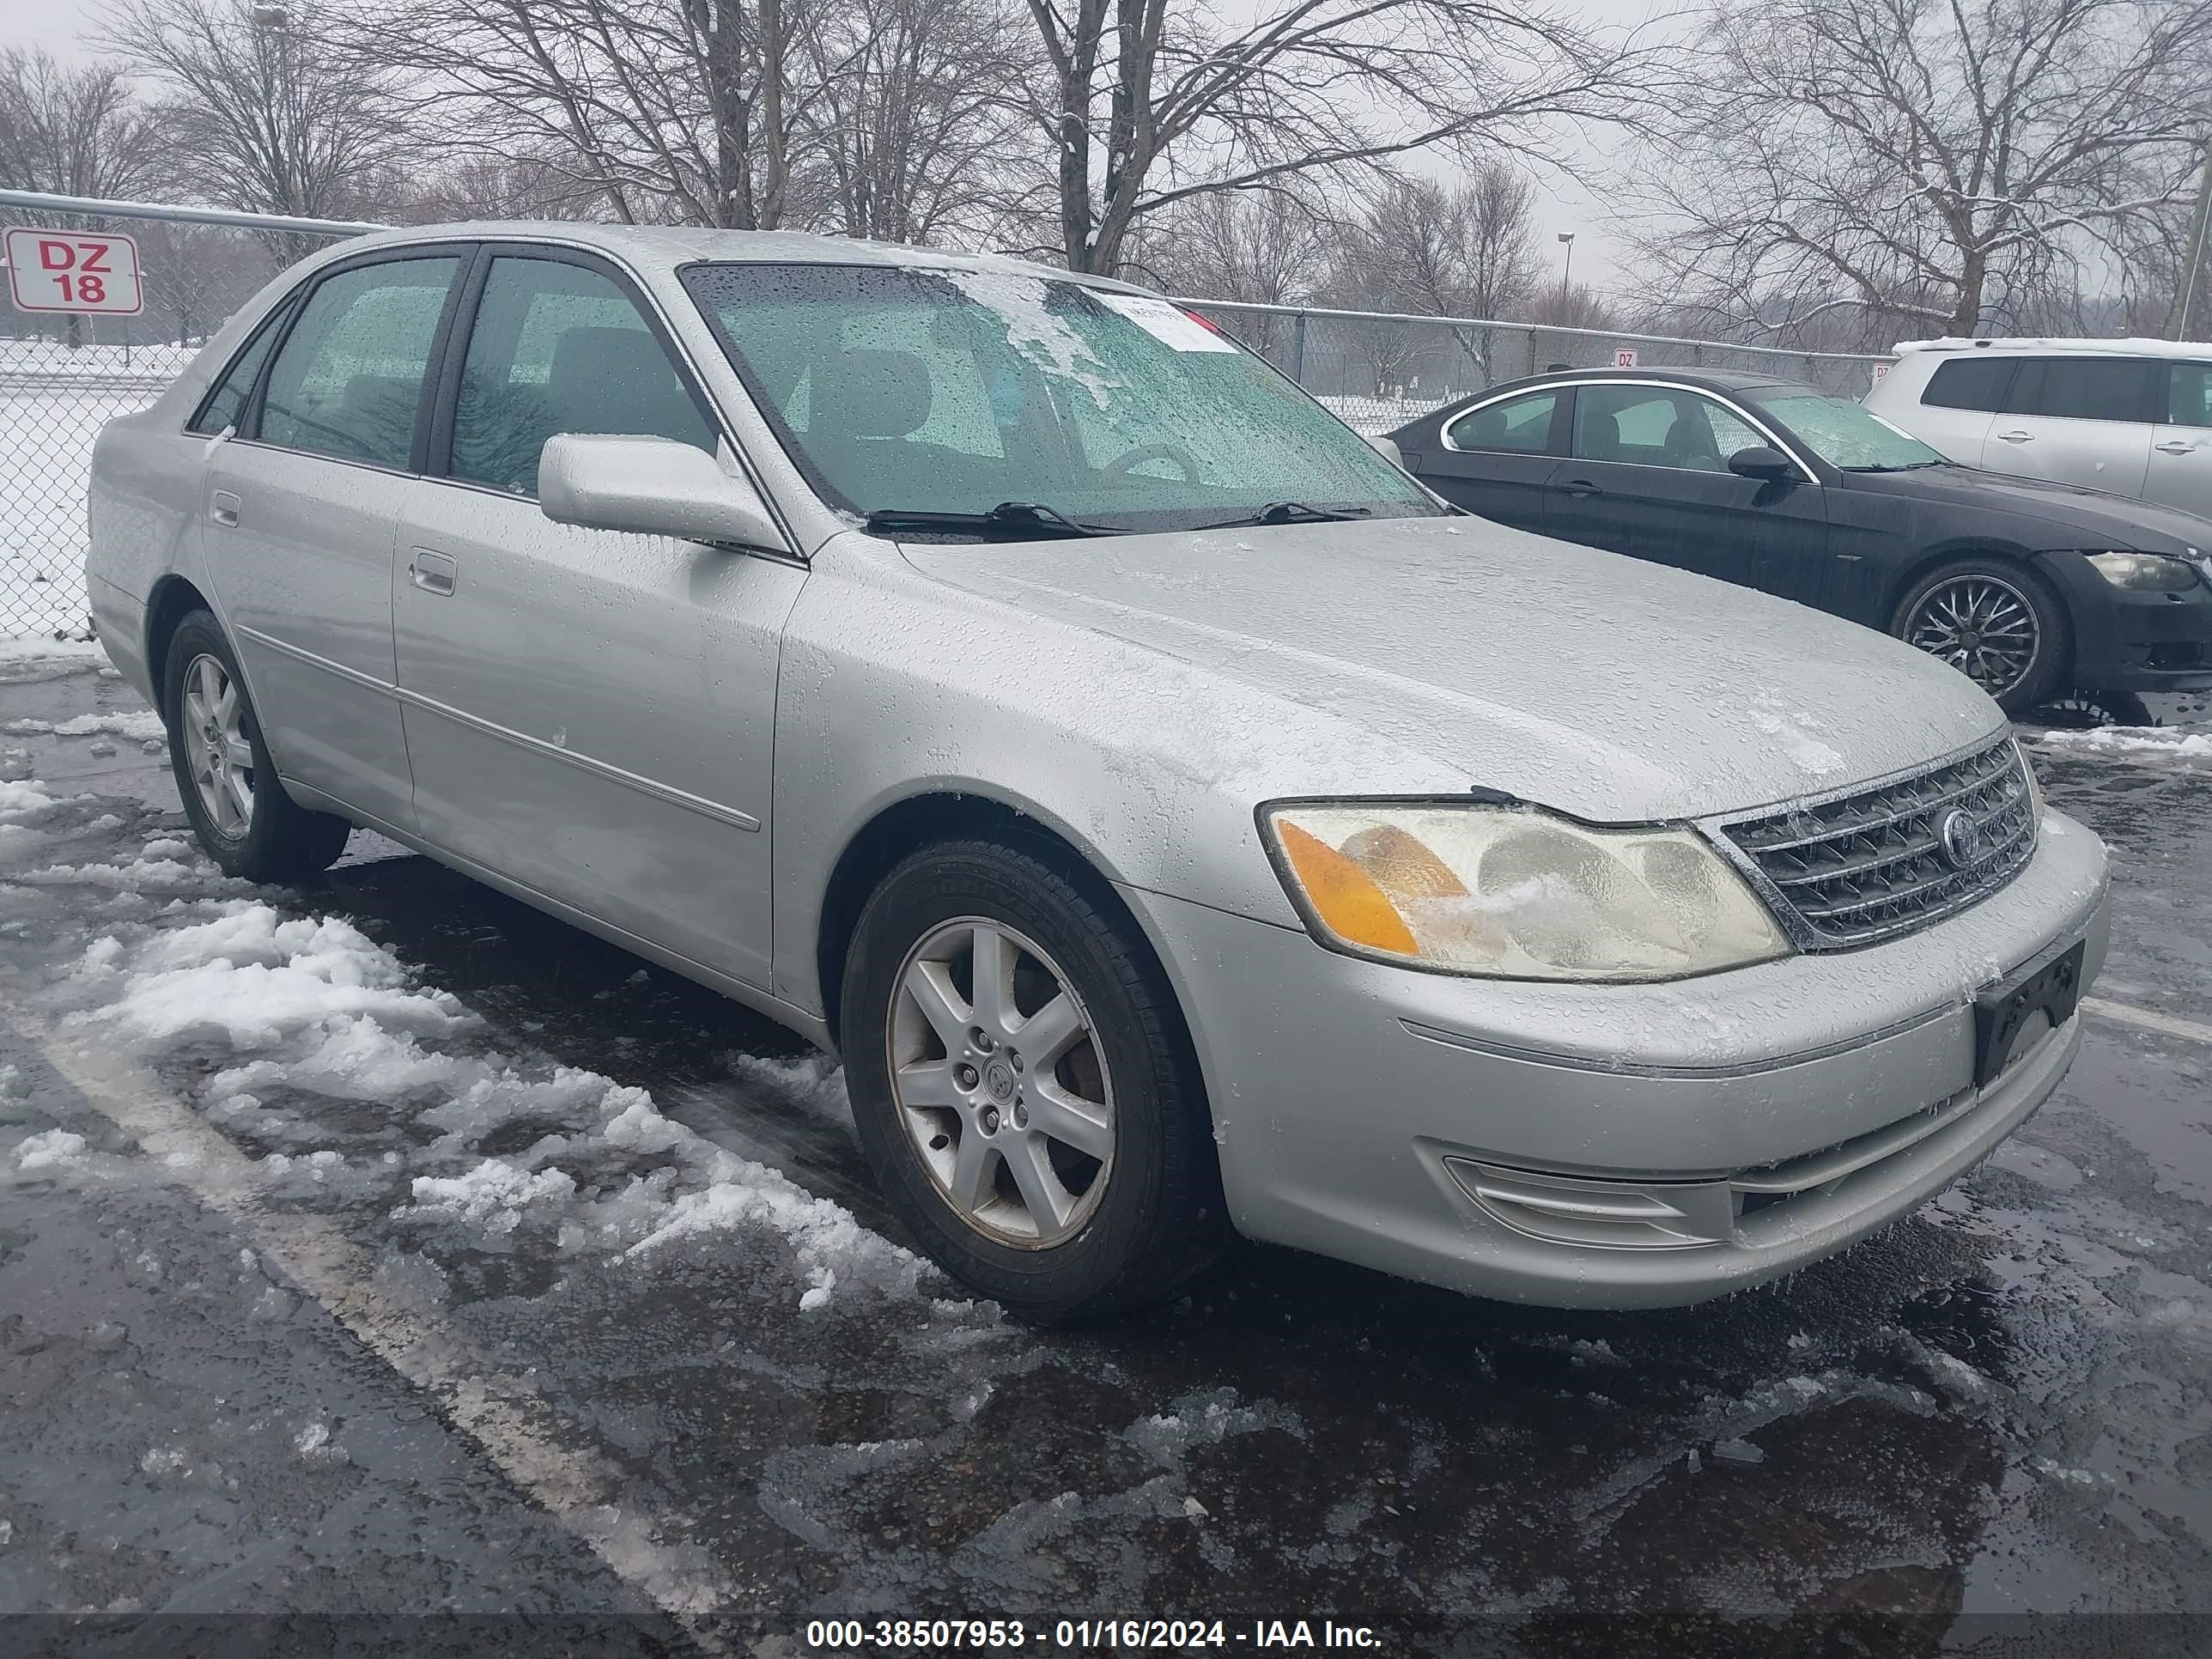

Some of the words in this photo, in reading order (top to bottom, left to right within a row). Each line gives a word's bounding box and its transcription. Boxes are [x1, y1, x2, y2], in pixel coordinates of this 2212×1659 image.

[39, 240, 112, 273] DZ
[52, 274, 106, 303] 18
[1619, 354, 1632, 367] DZ
